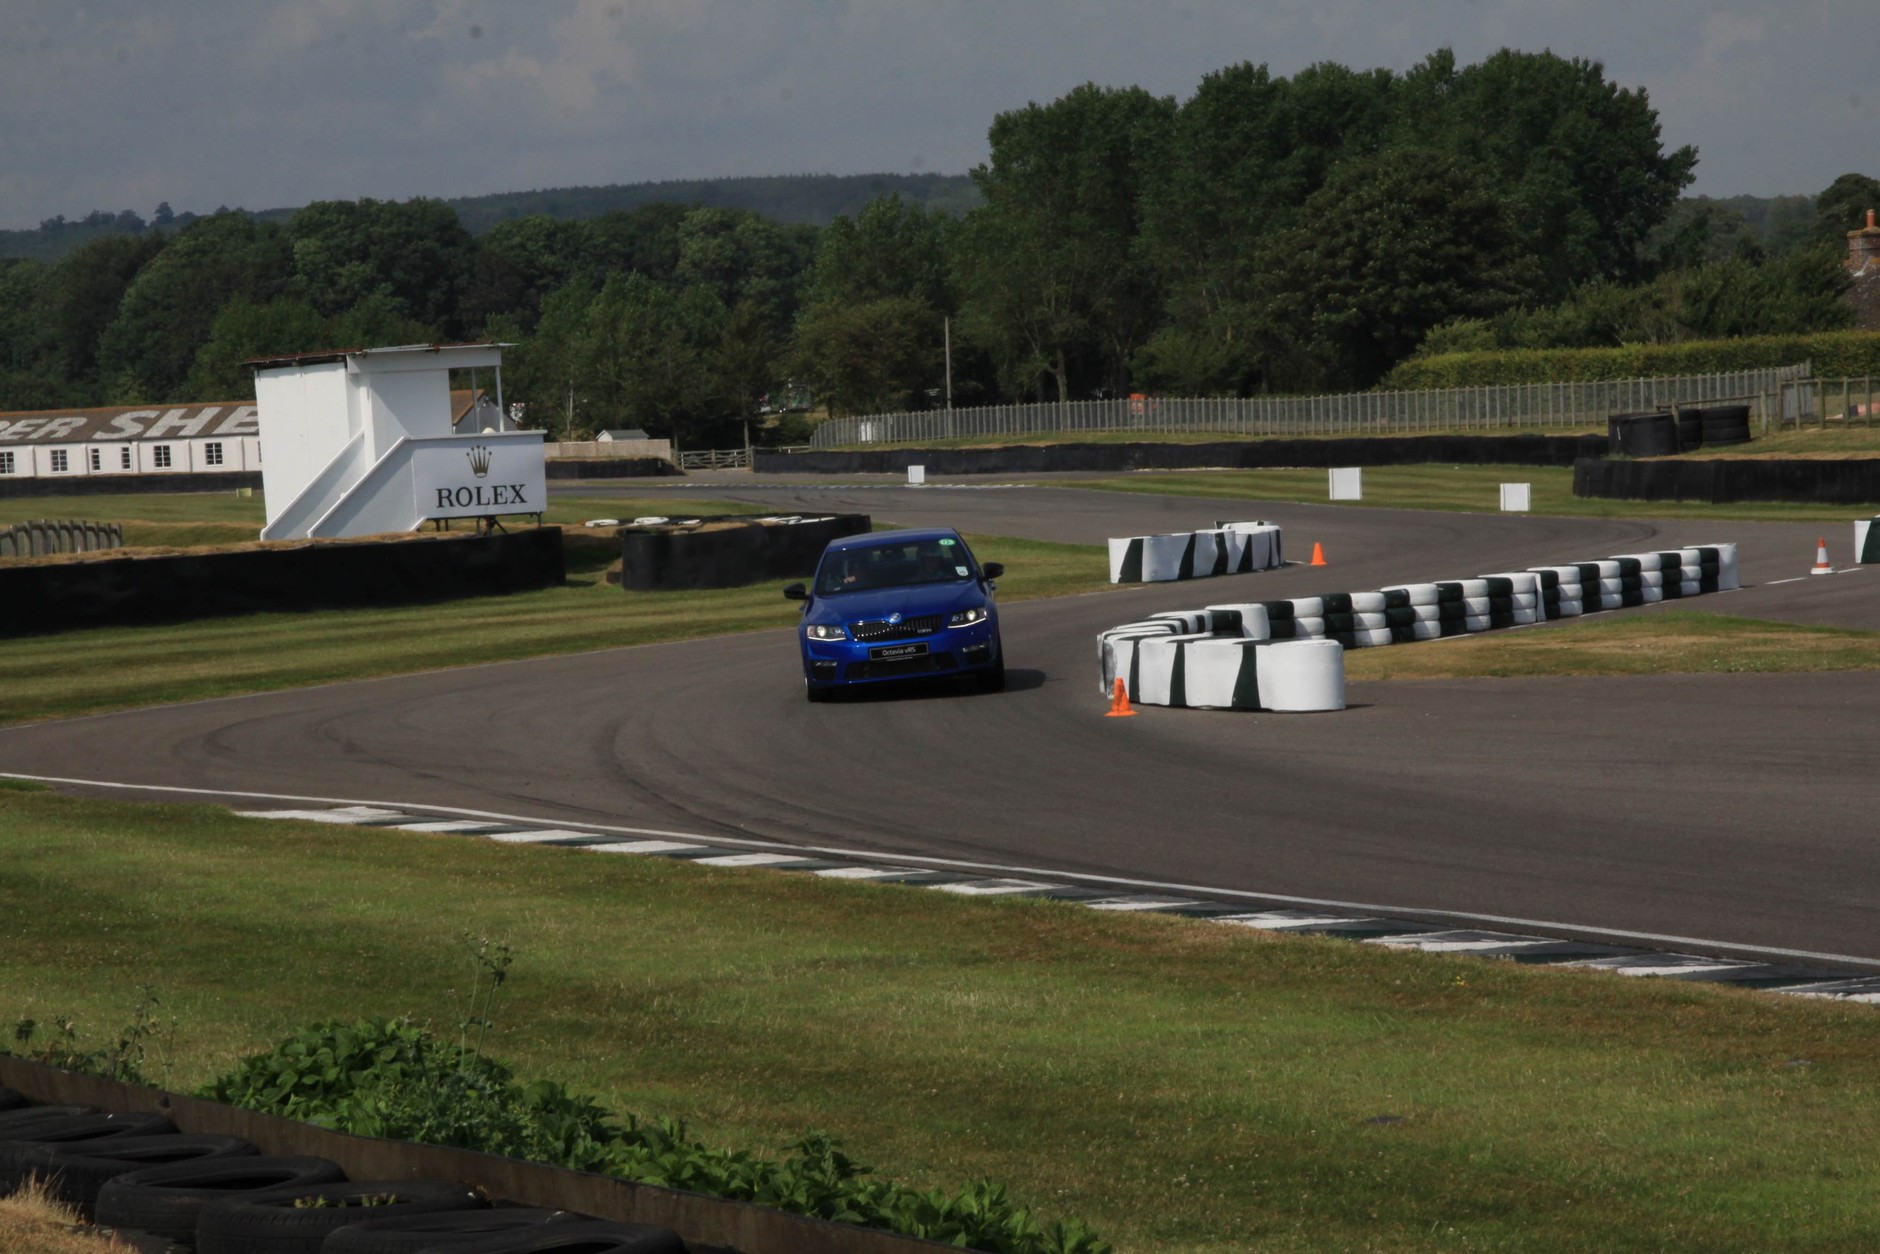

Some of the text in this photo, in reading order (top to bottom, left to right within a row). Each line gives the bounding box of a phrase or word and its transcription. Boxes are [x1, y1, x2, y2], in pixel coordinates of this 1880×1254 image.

[0, 417, 88, 440] ER
[435, 483, 528, 508] ROLEX
[882, 648, 904, 656] Octavia
